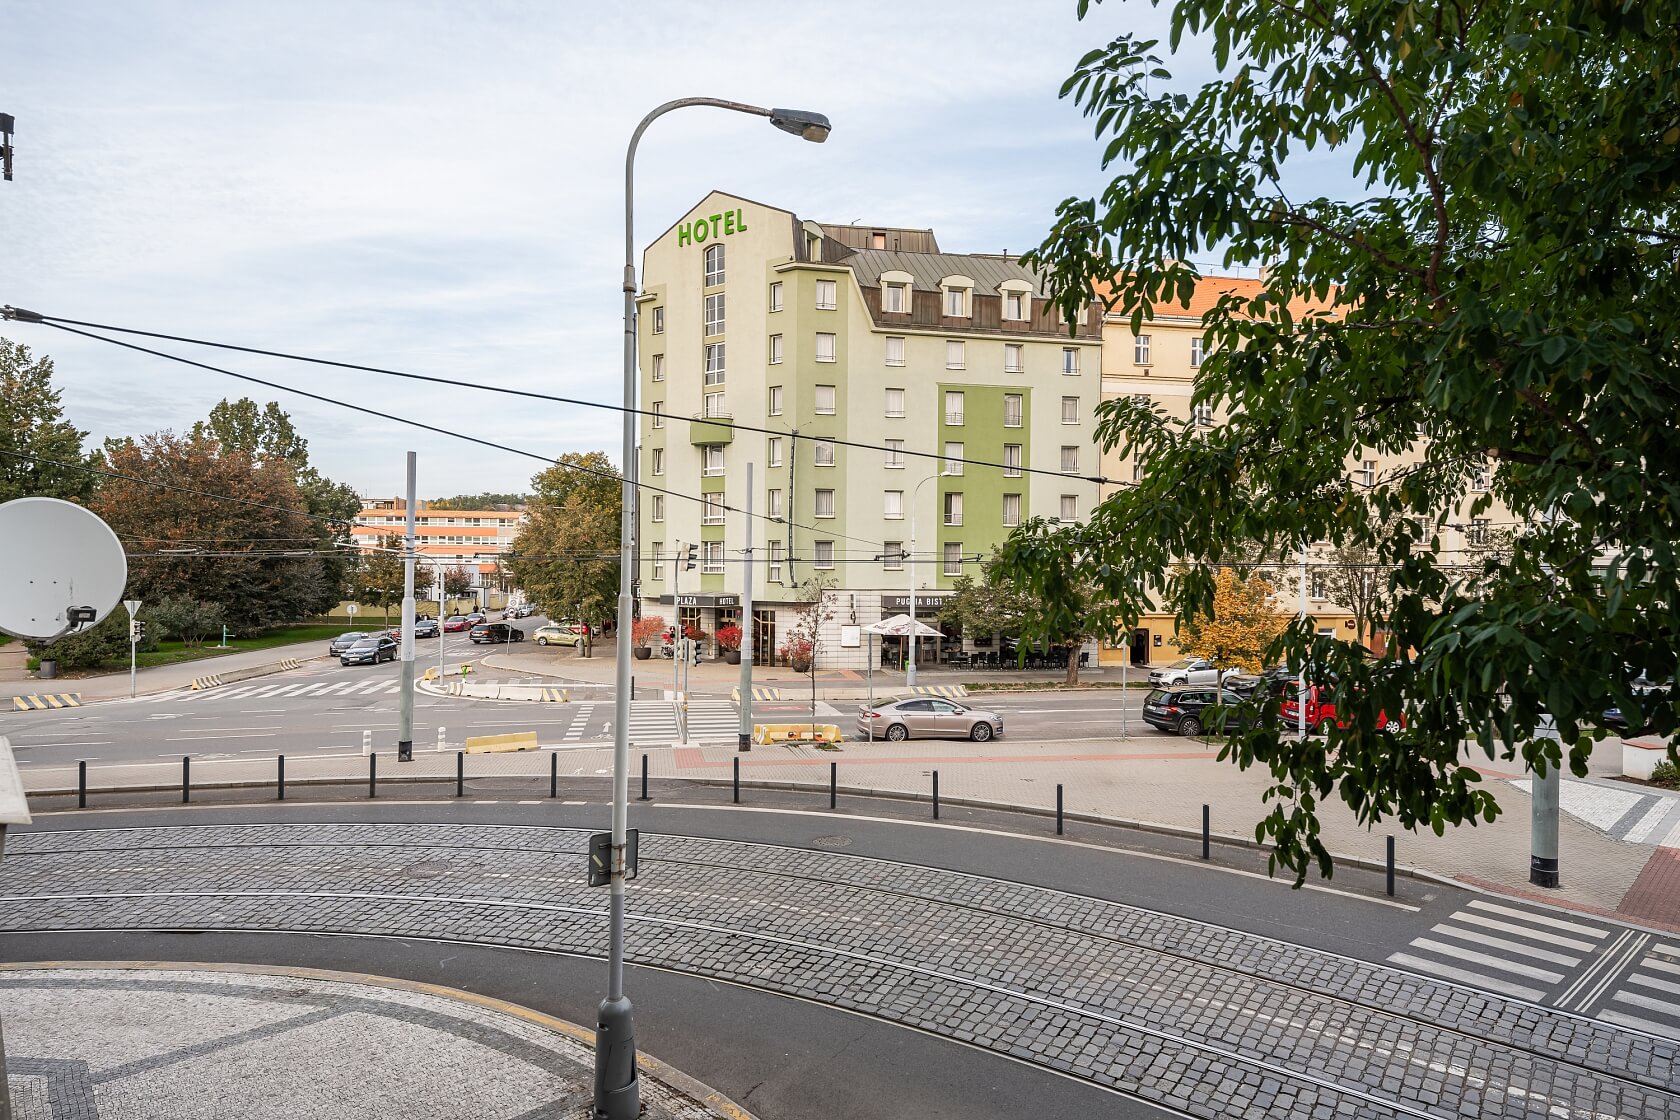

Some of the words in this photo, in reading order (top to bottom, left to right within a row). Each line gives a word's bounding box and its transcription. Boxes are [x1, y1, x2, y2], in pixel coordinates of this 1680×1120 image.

[678, 208, 748, 248] HOTEL
[676, 596, 697, 606] PLAZA
[719, 597, 734, 605] HOTEL
[895, 597, 923, 606] PUGIA
[926, 597, 950, 606] BIST
